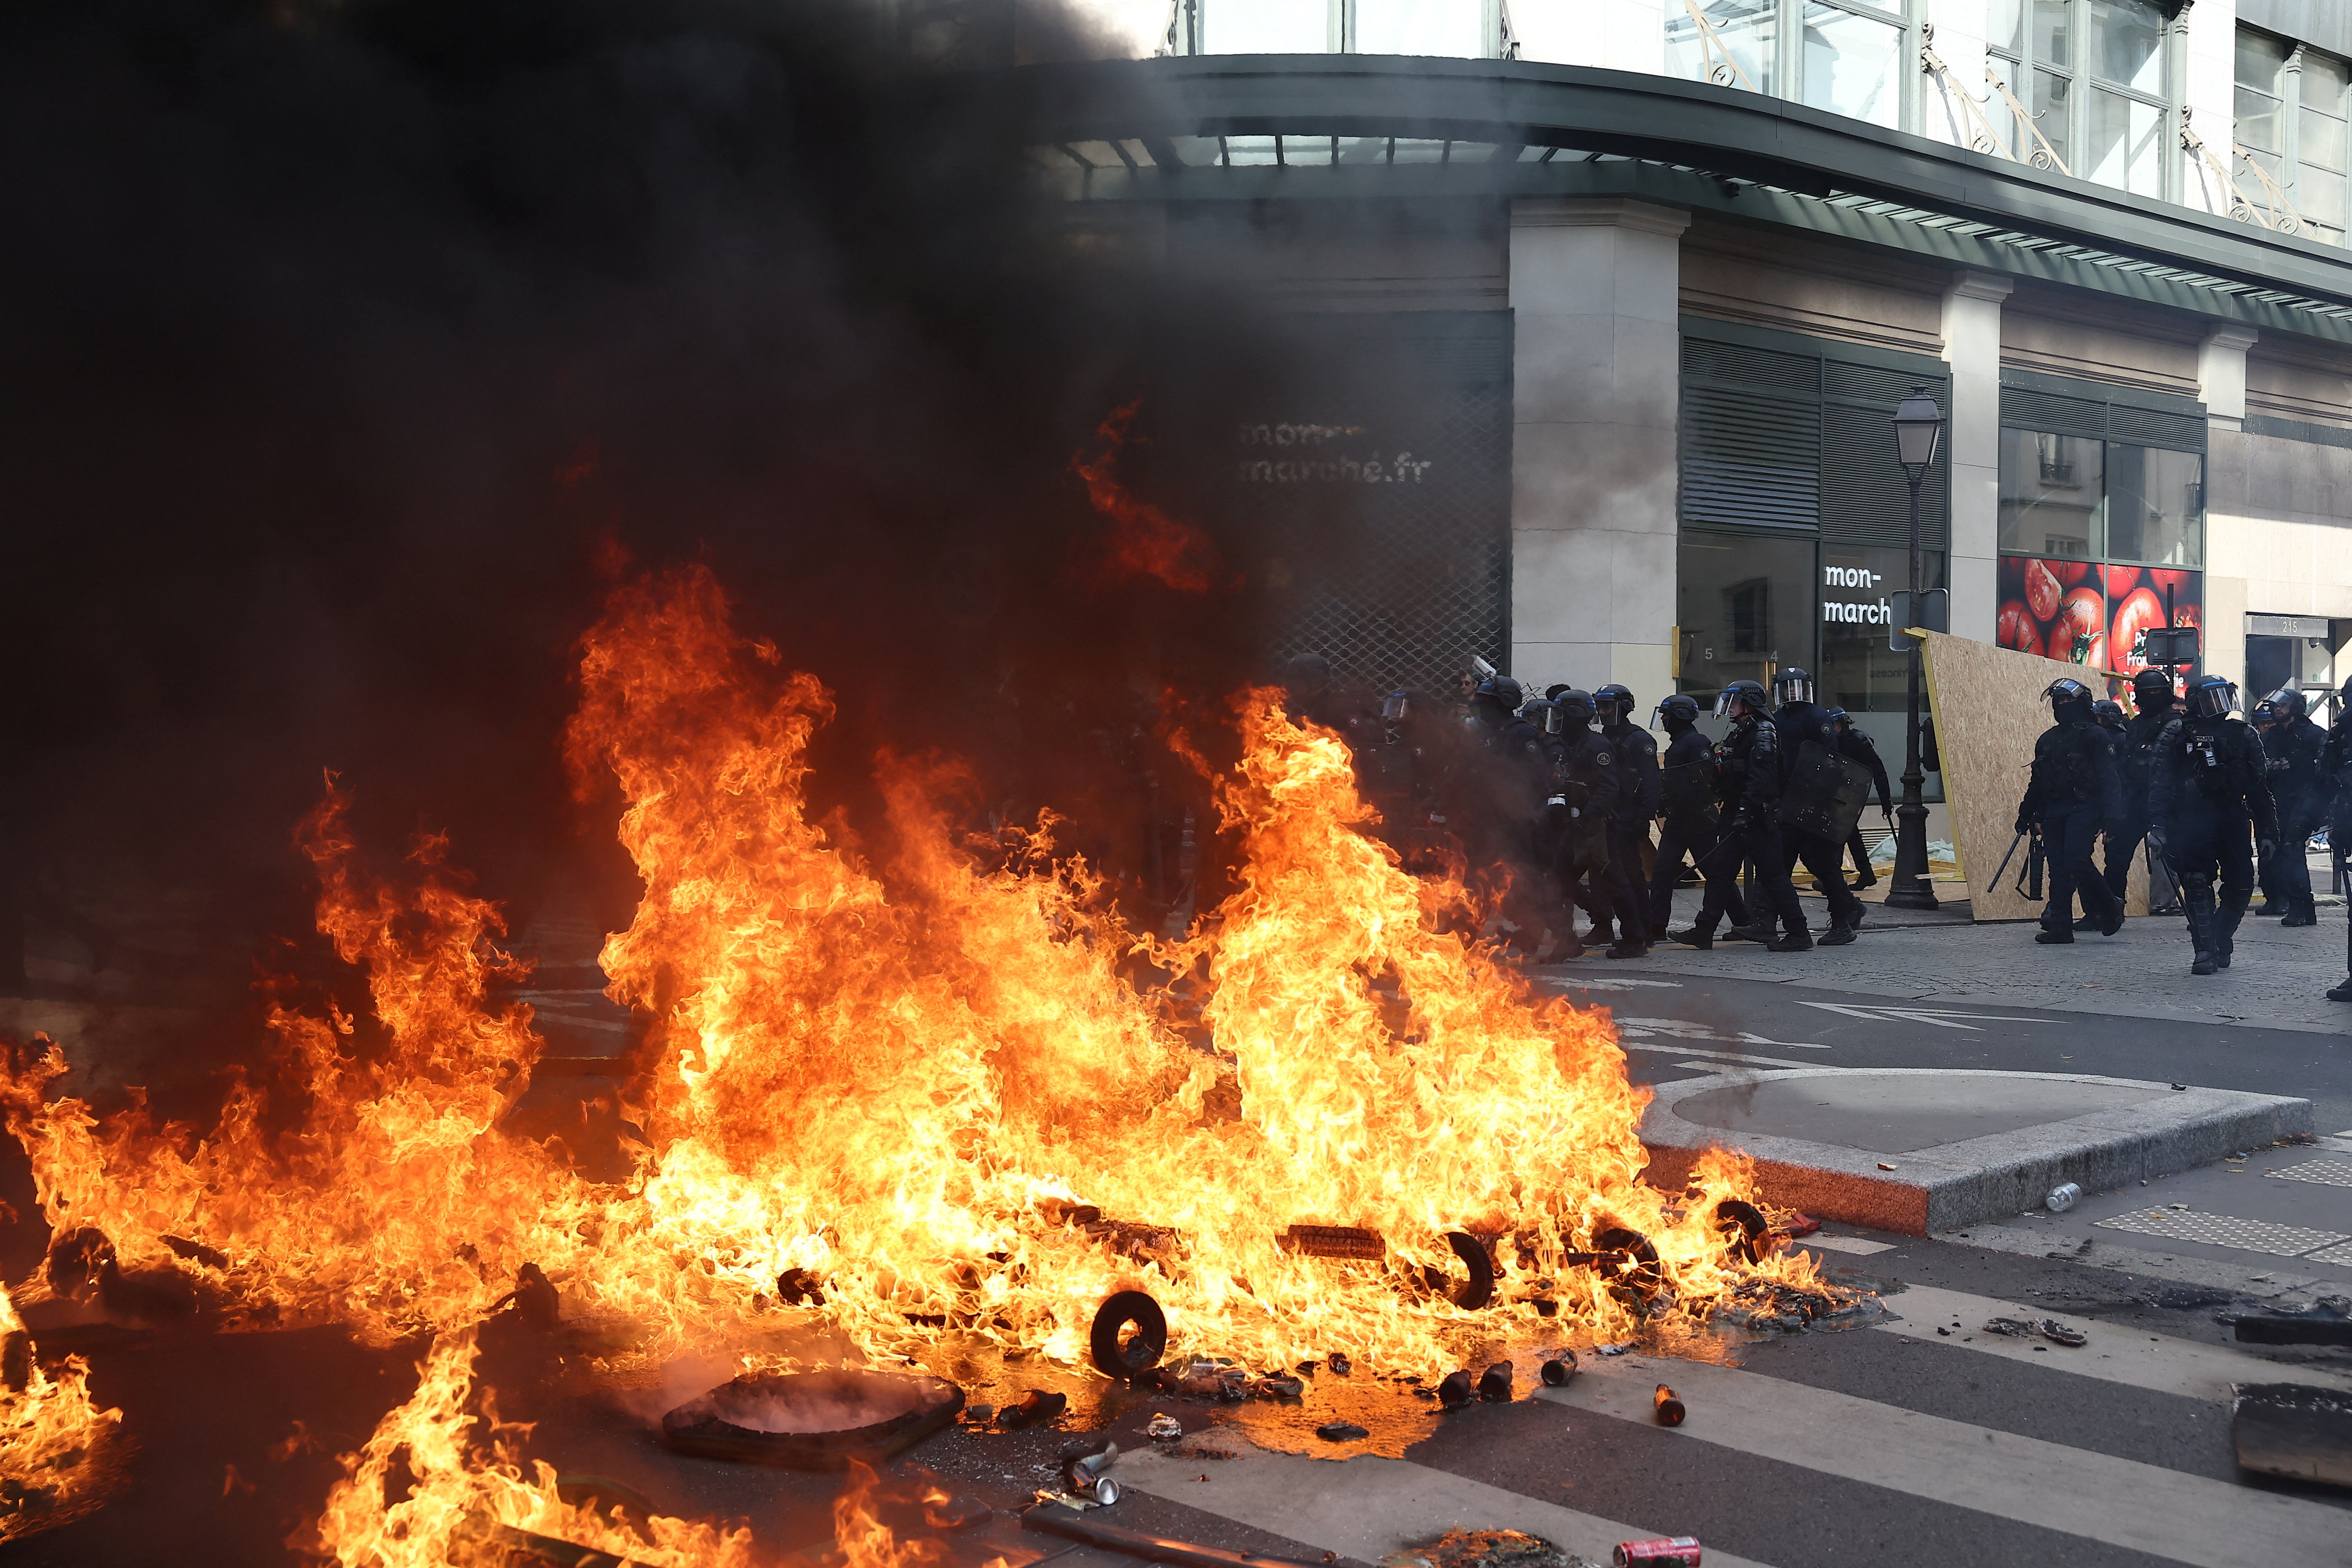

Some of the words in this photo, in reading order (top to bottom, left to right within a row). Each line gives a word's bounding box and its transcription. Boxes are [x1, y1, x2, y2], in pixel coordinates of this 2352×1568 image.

[1824, 566, 1881, 588] mon-
[1823, 597, 1891, 625] march
[2283, 621, 2297, 633] 215
[1705, 648, 1713, 660] 5
[1770, 650, 1779, 662] 4
